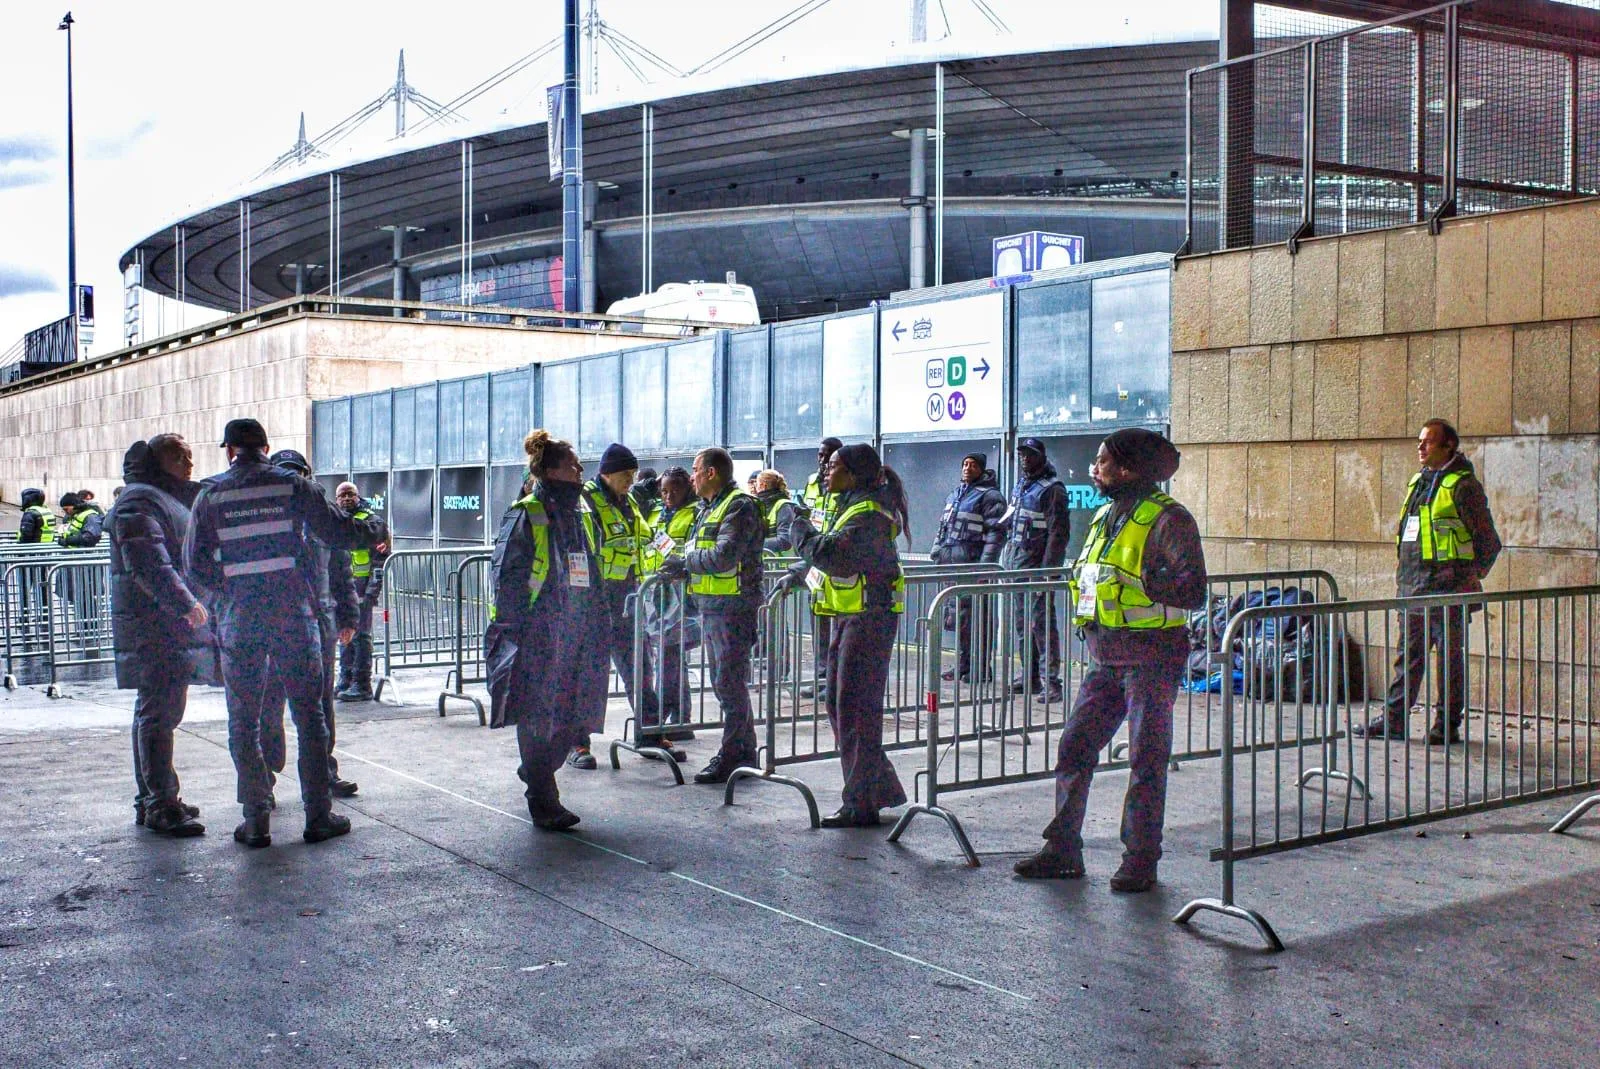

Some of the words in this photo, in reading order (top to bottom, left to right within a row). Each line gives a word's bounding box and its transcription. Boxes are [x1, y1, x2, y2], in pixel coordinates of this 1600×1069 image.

[997, 237, 1023, 250] GUICHET
[1042, 235, 1072, 247] GUICHET
[929, 367, 943, 380] RER
[951, 363, 963, 380] D
[930, 399, 941, 415] M
[949, 397, 965, 415] 14
